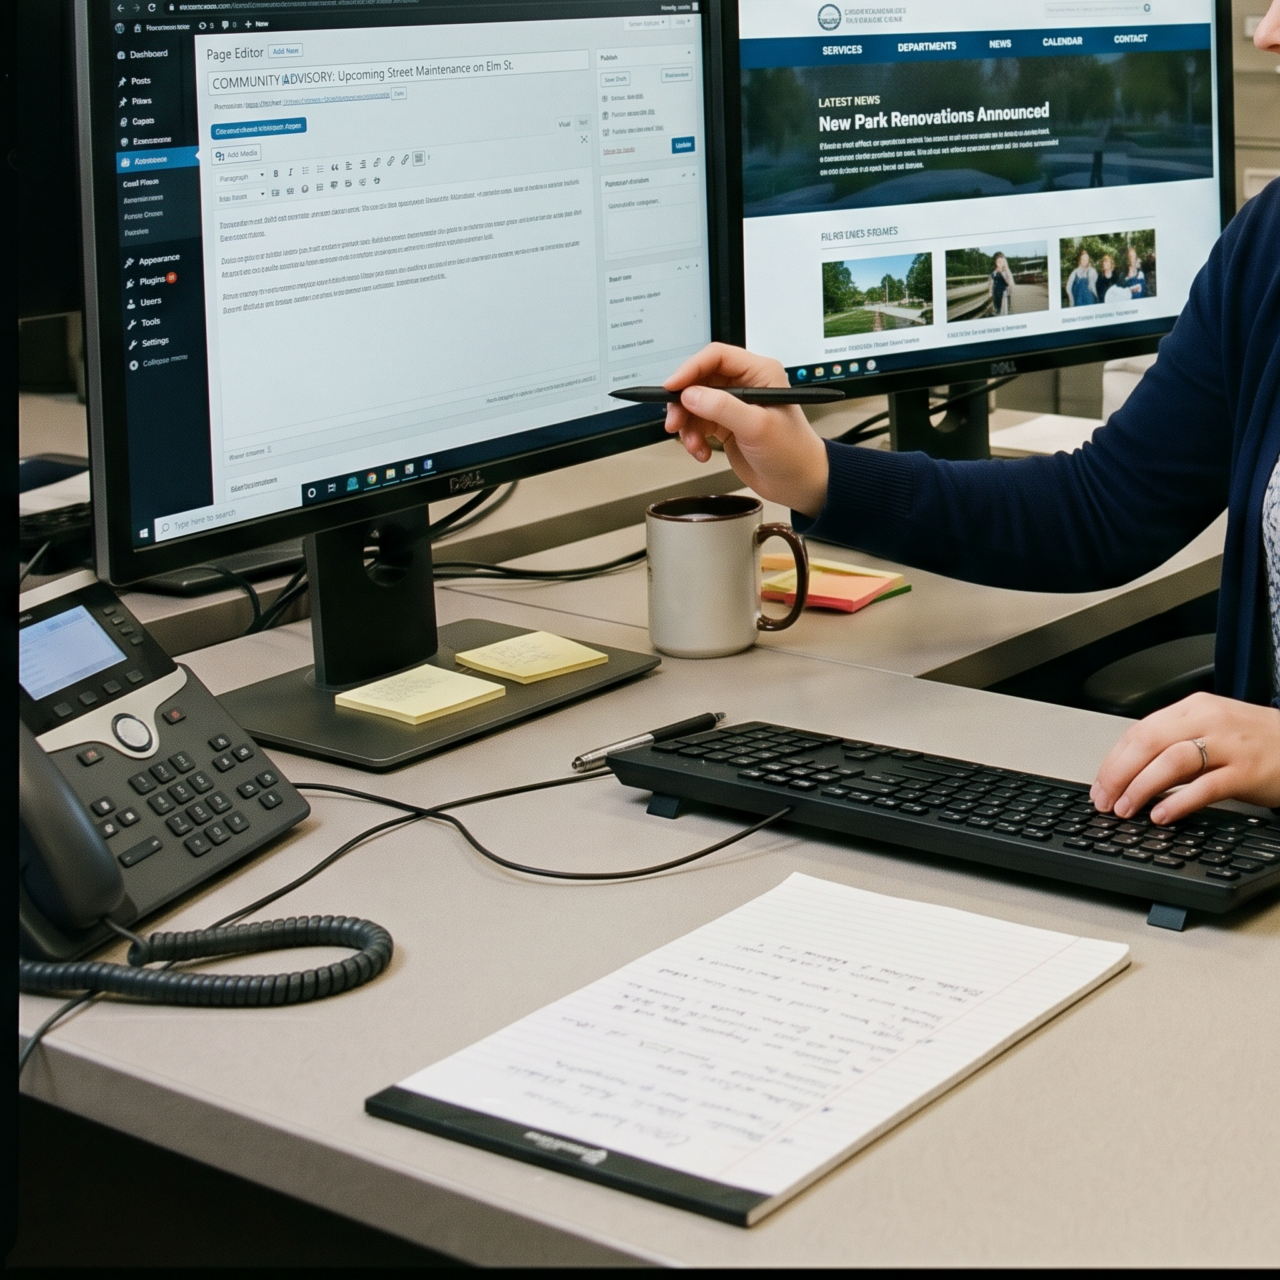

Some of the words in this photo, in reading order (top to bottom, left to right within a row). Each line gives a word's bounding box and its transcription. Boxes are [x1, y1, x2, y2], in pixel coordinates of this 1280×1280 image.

[989, 39, 1012, 49] NEWS
[1042, 36, 1083, 47] CALENDAR
[1113, 33, 1149, 44] CONTACT
[822, 44, 863, 55] SERVICES
[897, 41, 957, 53] DEPARTMENTS
[206, 48, 232, 63] Page
[234, 46, 264, 60] Editor
[212, 74, 281, 90] COMMUNITY
[282, 71, 335, 85] ADVISORY:
[338, 68, 385, 84] Upcoming
[387, 66, 414, 79] Street
[415, 63, 471, 77] Maintenance
[472, 64, 484, 72] on
[486, 60, 502, 72] Elm
[503, 59, 514, 71] St.
[131, 77, 152, 85] Posts
[818, 96, 853, 108] LATEST
[854, 95, 881, 106] NEWS
[819, 115, 852, 132] New
[854, 111, 888, 130] Park
[890, 107, 975, 128] Renovations
[977, 100, 1050, 122] Announced
[227, 151, 239, 159] Add
[240, 149, 258, 157] Media
[138, 254, 180, 266] Appearance
[140, 297, 162, 307] Users
[141, 317, 161, 327] Tools
[141, 337, 170, 348] Settings
[173, 518, 190, 530] Type
[190, 515, 206, 526] here
[206, 514, 214, 522] to
[215, 509, 236, 520] search
